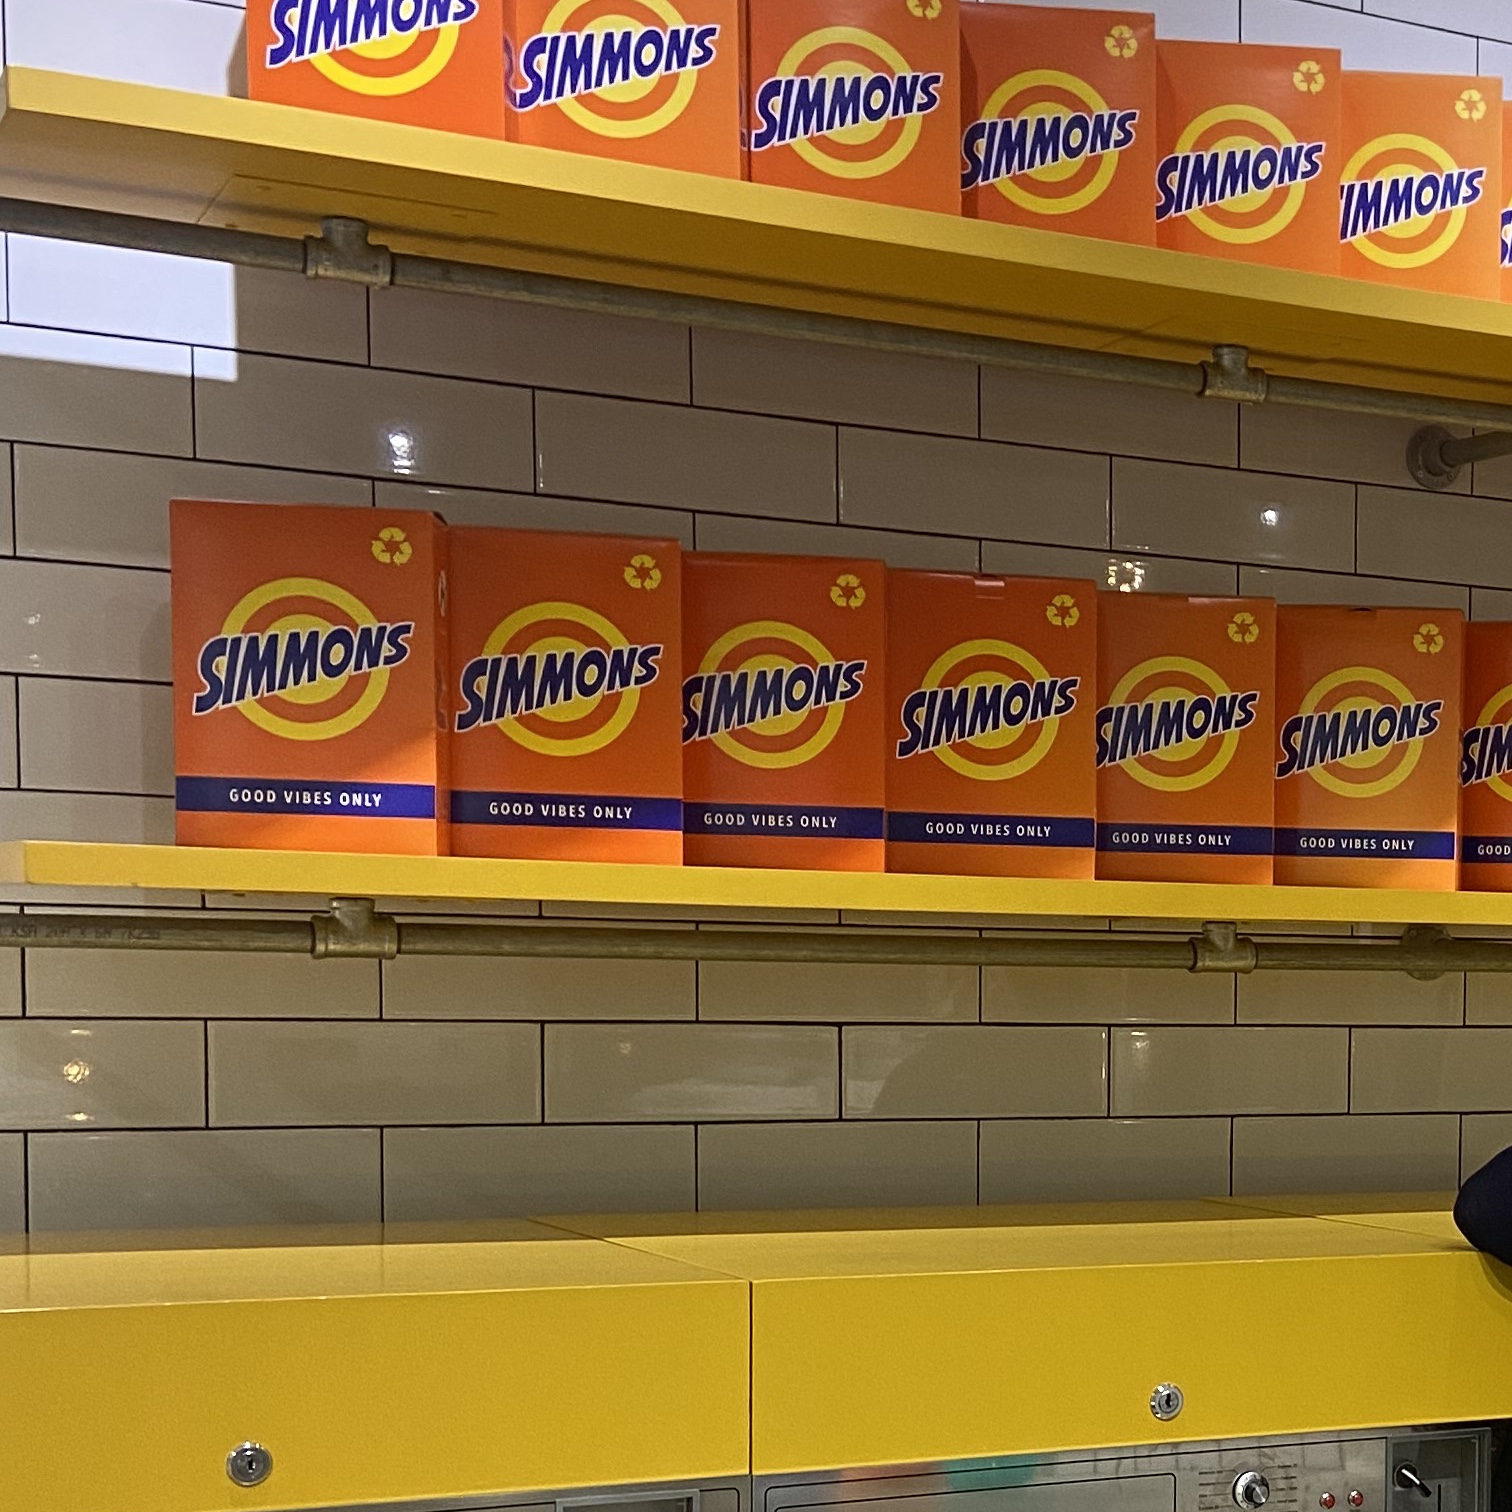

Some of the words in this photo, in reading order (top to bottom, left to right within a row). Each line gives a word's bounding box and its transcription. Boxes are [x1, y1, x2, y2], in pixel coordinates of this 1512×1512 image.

[267, 0, 478, 67] SIMMONS
[514, 24, 718, 111] SIMMONS
[752, 72, 943, 151] SIMMONS
[962, 110, 1139, 188] SIMMONS
[1155, 142, 1325, 220] SIMMONS
[1340, 168, 1486, 240] IMMONS
[195, 622, 414, 715] SIMMONS
[456, 645, 663, 732] SIMMONS
[682, 661, 866, 744] SIMMONS
[897, 677, 1080, 758] SIMMONS
[1096, 691, 1258, 768] SIMMONS
[1276, 700, 1443, 779] SIMMONS
[230, 789, 276, 803] GOOD
[284, 791, 332, 805] VIBES
[340, 792, 382, 807] ONLY
[490, 802, 534, 815] GOOD
[541, 804, 586, 817] VIBES
[593, 806, 633, 819] ONLY
[704, 813, 745, 825] GOOD
[752, 815, 793, 827] VIBES
[801, 816, 837, 828] ONLY
[926, 822, 965, 834] GOOD
[971, 824, 1010, 836] VIBES
[1017, 825, 1051, 837] ONLY
[1112, 832, 1149, 844] GOOD
[1155, 833, 1193, 845] VIBES
[1198, 834, 1232, 846] ONLY
[1300, 837, 1335, 848] GOOD
[1341, 838, 1377, 850] VIBES
[1383, 839, 1415, 851] ONLY
[1478, 844, 1511, 856] GOOD
